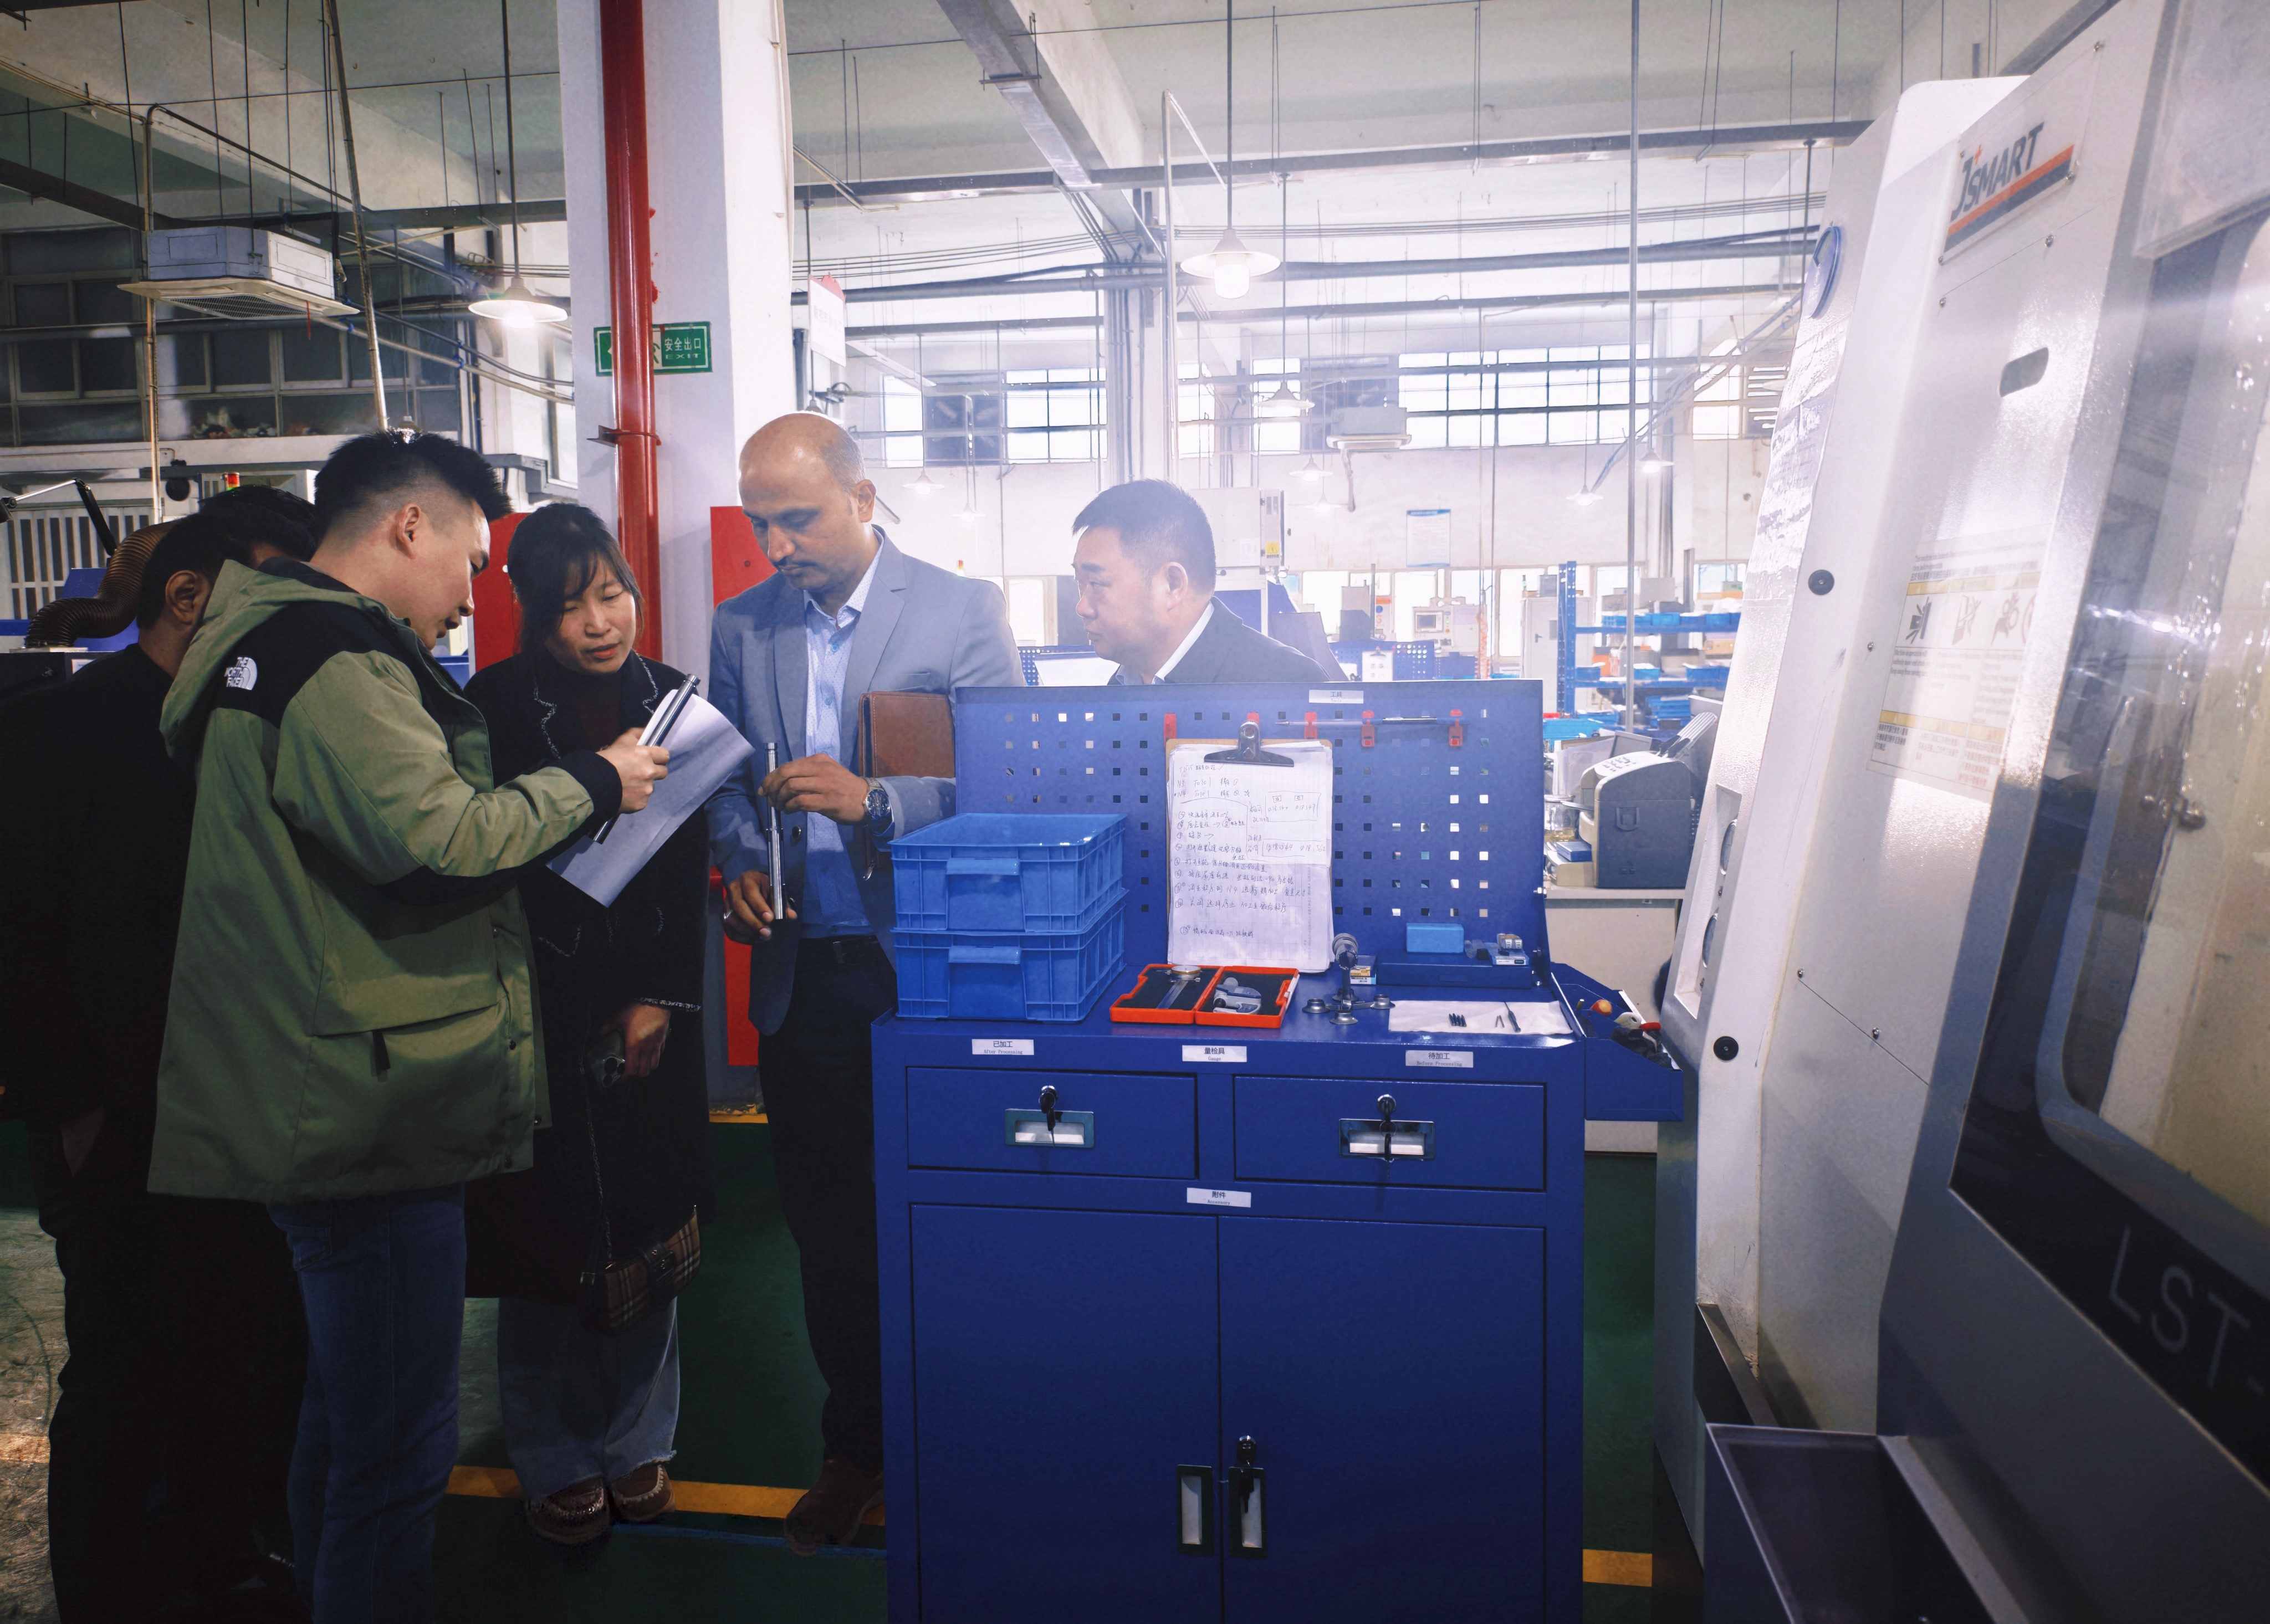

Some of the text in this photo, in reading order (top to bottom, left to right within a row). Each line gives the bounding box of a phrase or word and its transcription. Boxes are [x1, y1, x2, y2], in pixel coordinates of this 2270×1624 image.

[664, 337, 701, 352] 安全出口
[236, 657, 249, 667] THE
[226, 677, 242, 688] FACE
[1428, 1052, 1450, 1060] 待加工
